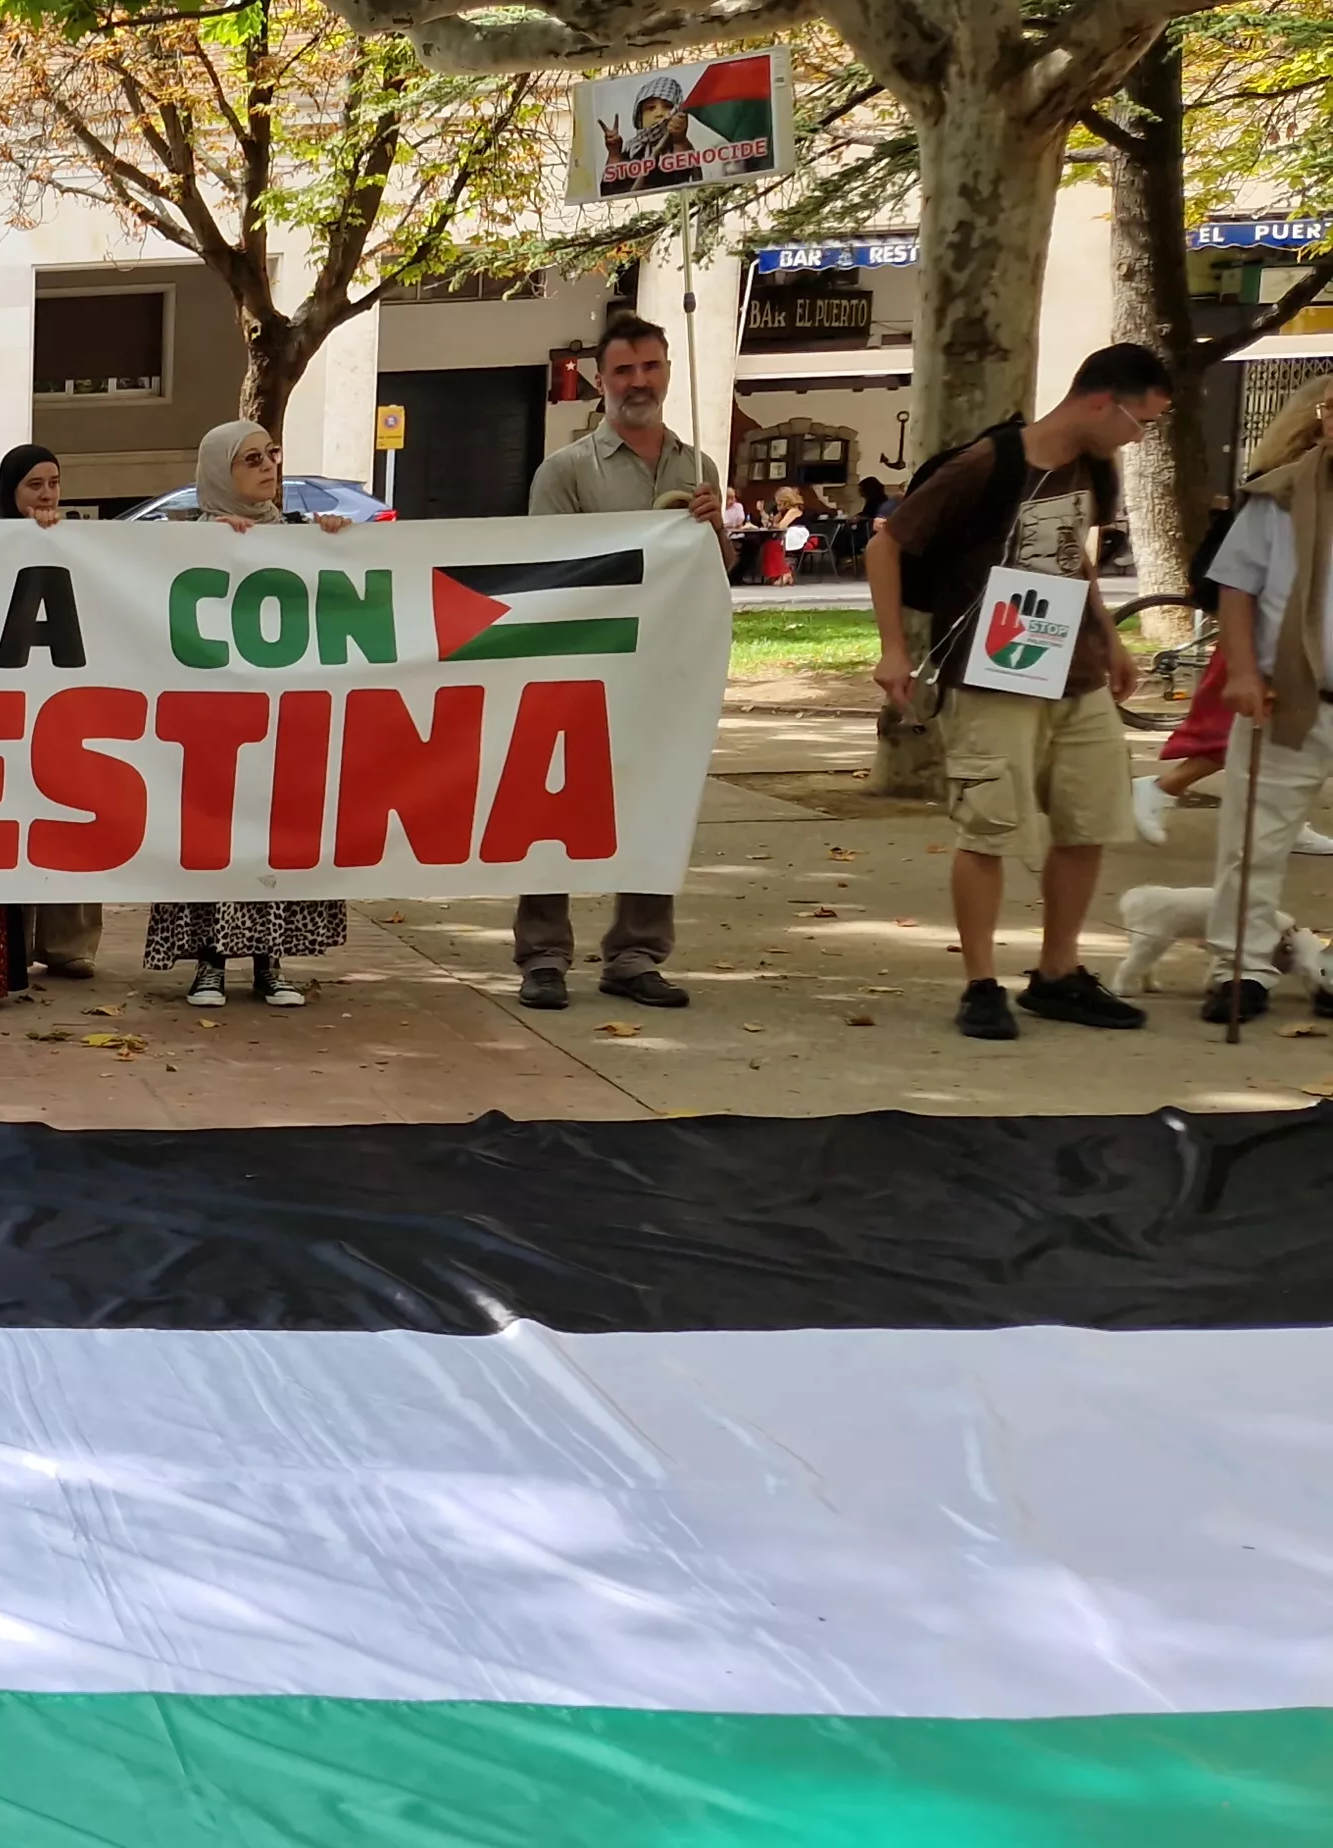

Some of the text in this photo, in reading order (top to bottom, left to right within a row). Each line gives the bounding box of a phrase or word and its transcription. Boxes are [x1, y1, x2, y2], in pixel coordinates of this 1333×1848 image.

[603, 137, 768, 182] STOP GENOCIDE
[1198, 222, 1333, 243] EL PUER
[779, 251, 822, 267] BAR
[795, 299, 813, 327] EL
[815, 299, 868, 327] PUERTO
[169, 567, 399, 669] CON
[1030, 620, 1069, 637] STOP
